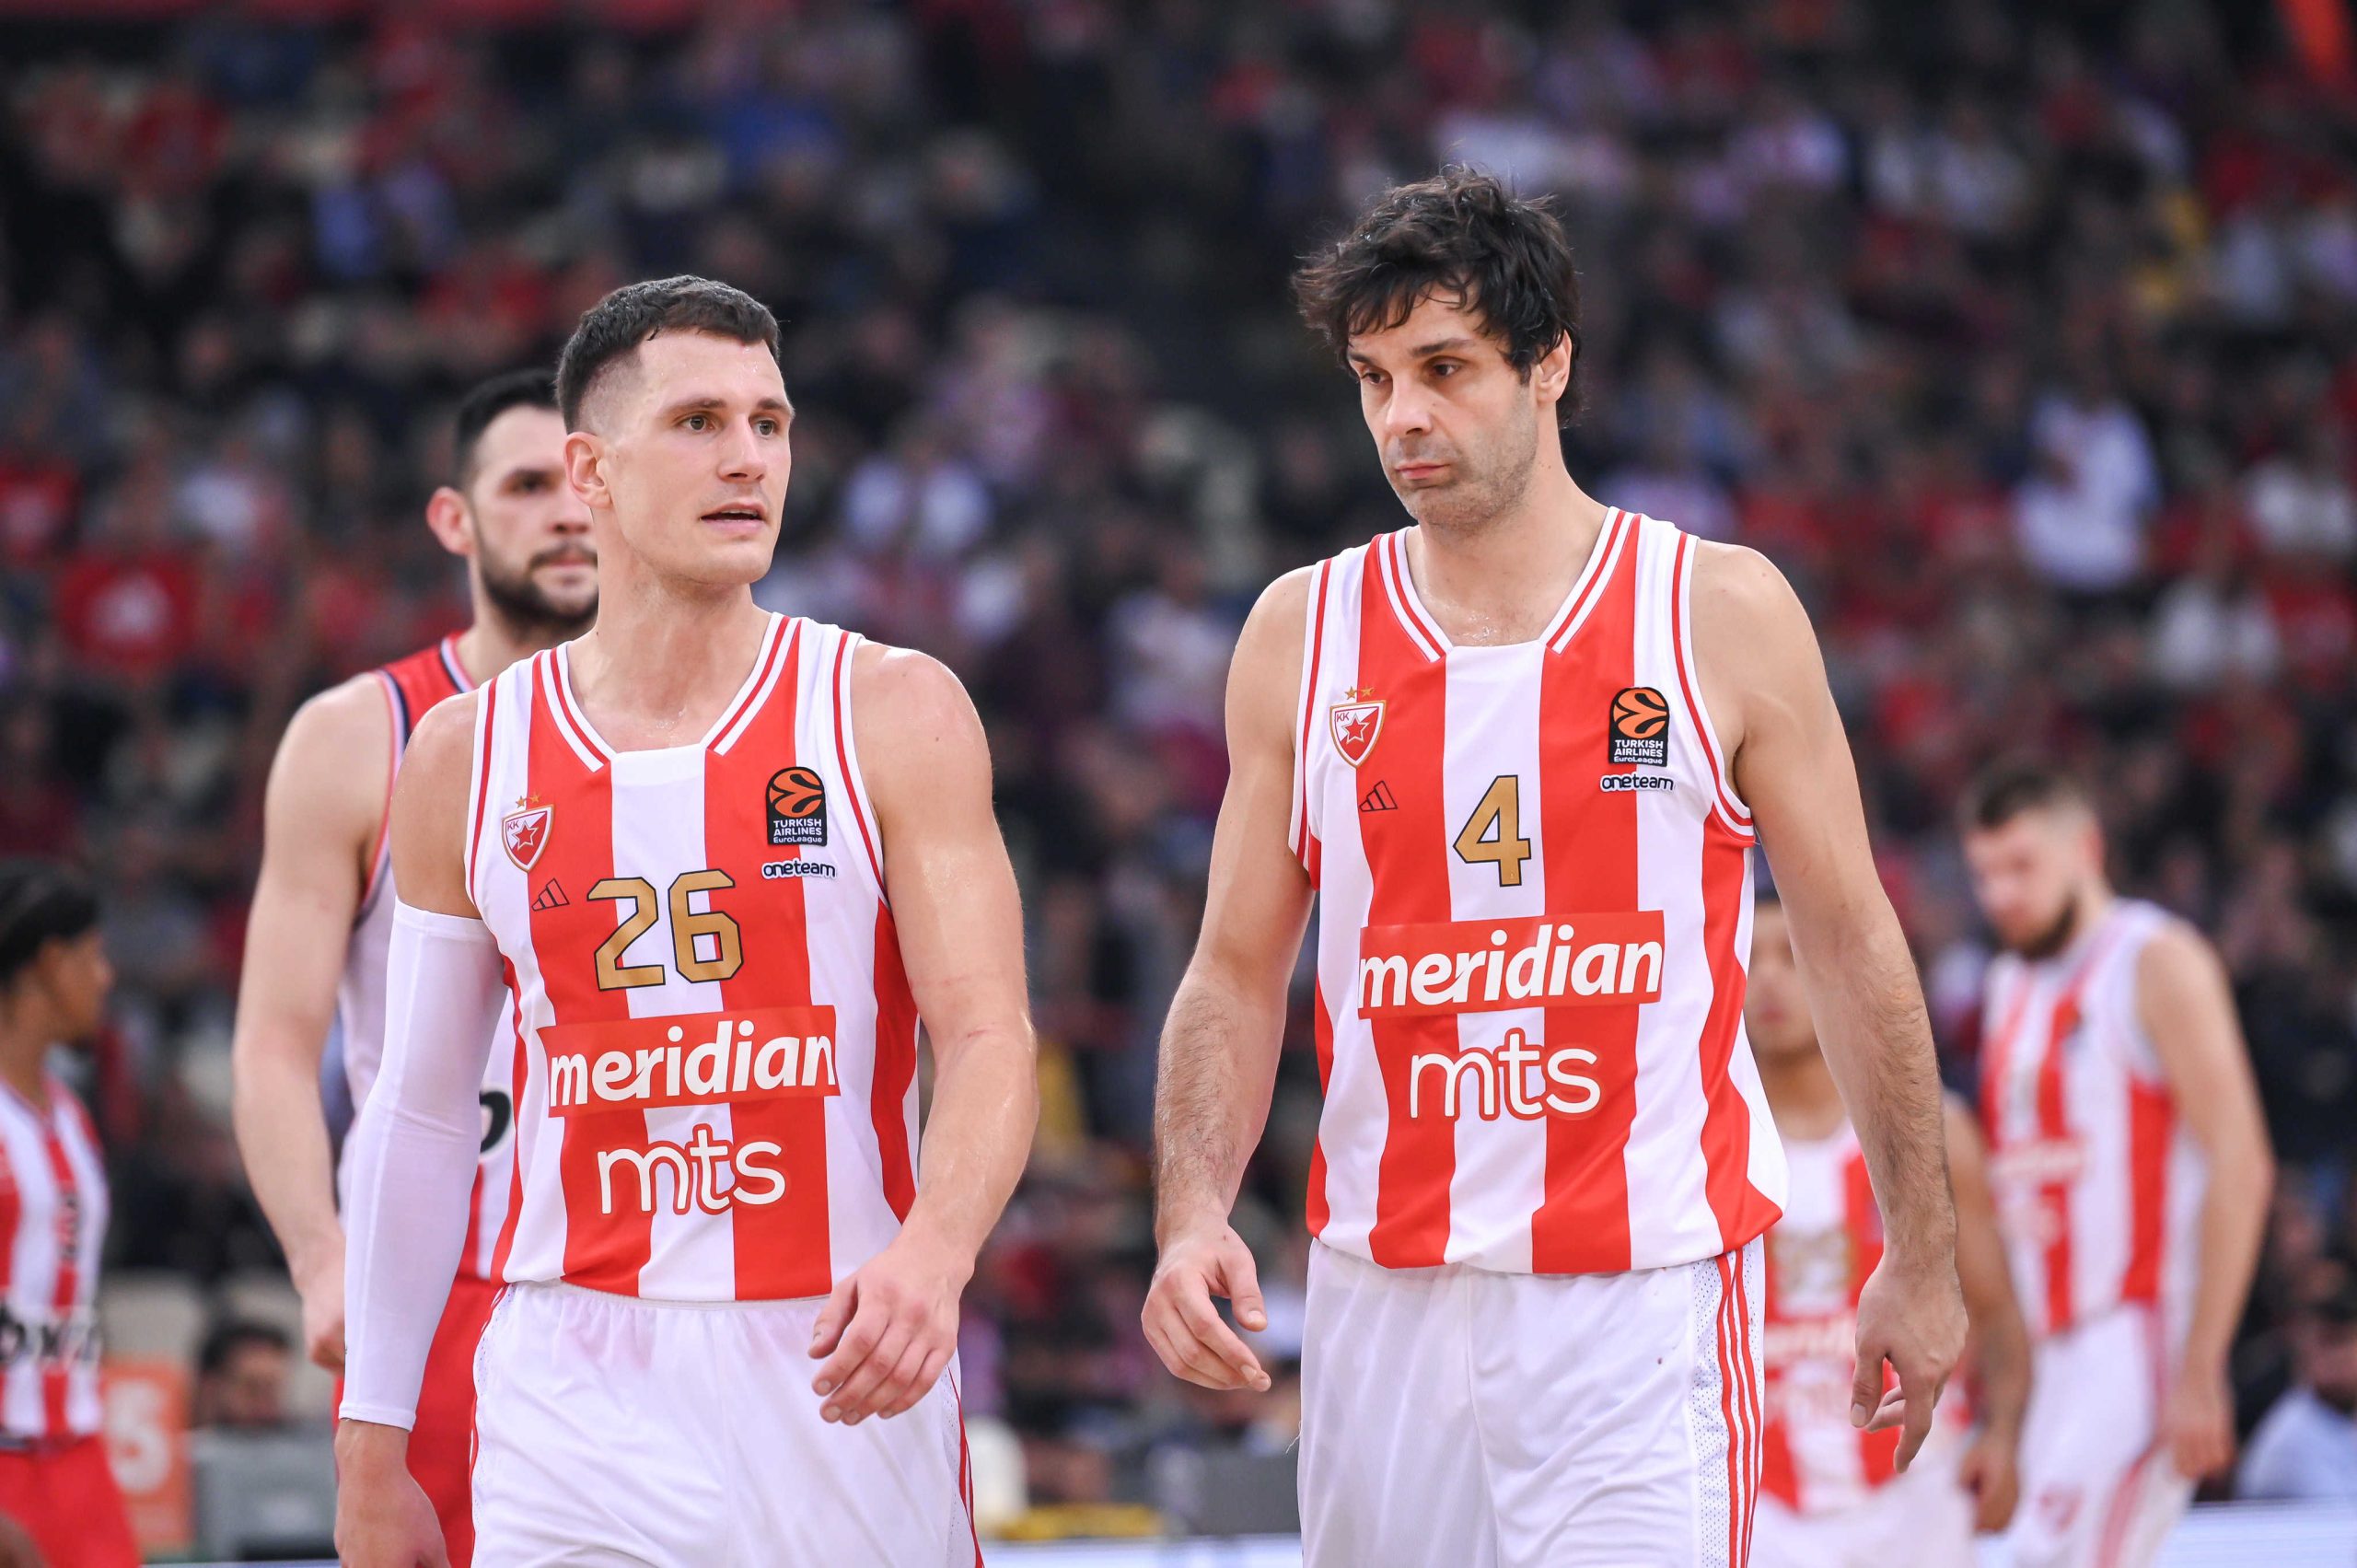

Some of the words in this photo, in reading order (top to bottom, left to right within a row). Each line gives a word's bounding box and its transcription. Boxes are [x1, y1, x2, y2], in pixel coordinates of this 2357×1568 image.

[1613, 748, 1664, 758] AIRLINES
[1614, 739, 1664, 749] TURKISH
[1613, 755, 1664, 765] EuroLeague
[1601, 773, 1674, 791] oneteam
[772, 819, 822, 829] TURKISH
[772, 827, 822, 837] AIRLINES
[1452, 774, 1531, 887] 4
[762, 859, 836, 878] oneteam
[586, 867, 744, 992] 26
[1358, 923, 1664, 1010] meridian
[549, 1019, 838, 1108] meridian
[1410, 1032, 1602, 1120] mts
[597, 1128, 786, 1214] mts
